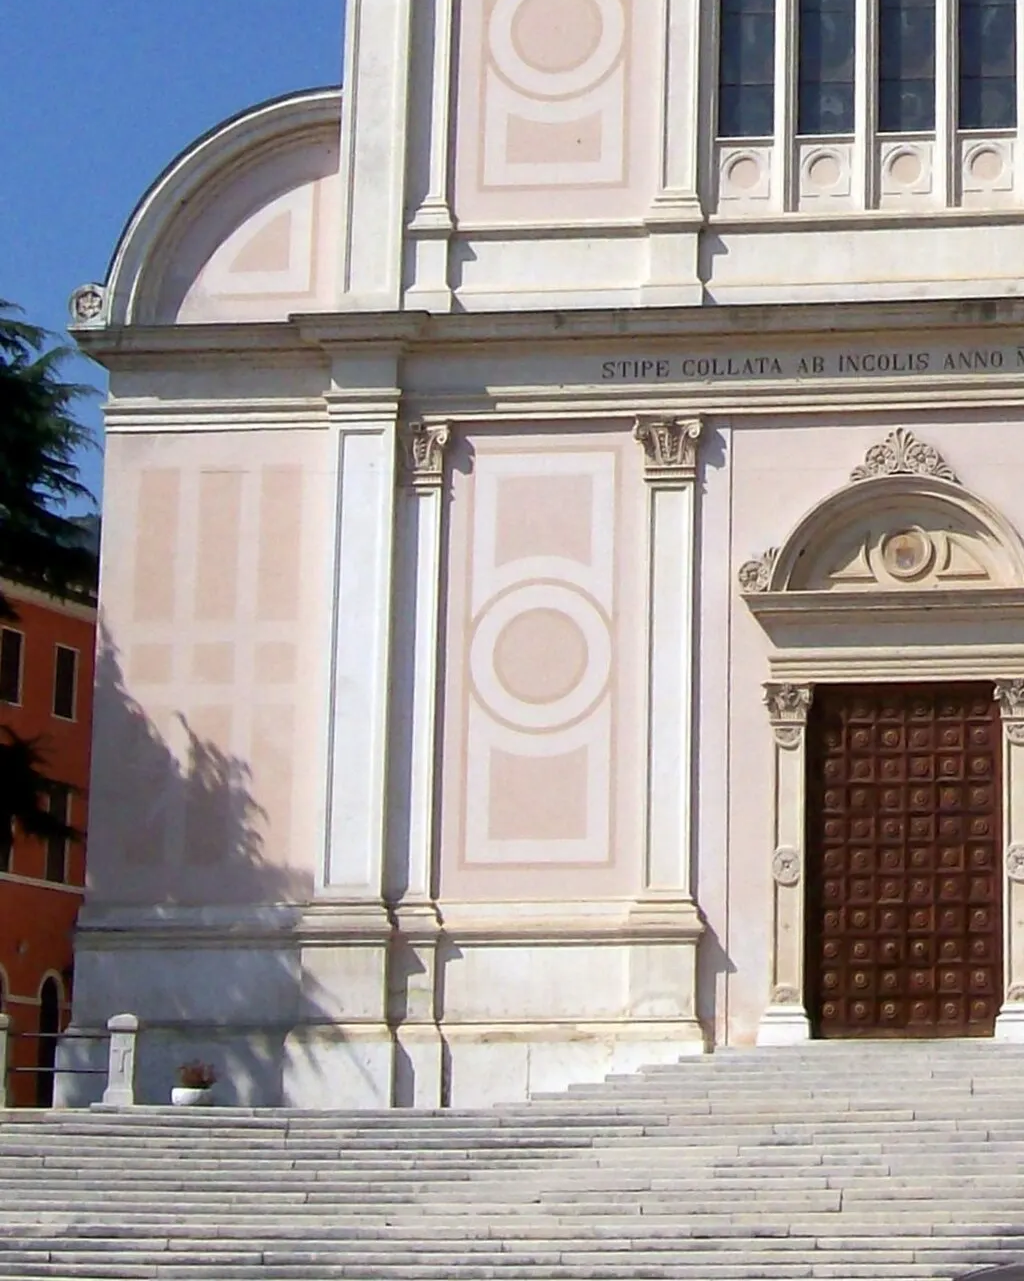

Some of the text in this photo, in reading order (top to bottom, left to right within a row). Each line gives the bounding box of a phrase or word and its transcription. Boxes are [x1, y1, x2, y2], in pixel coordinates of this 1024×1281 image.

[601, 359, 670, 379] STIPE
[682, 357, 783, 377] COLLATA
[797, 356, 825, 374] AB
[838, 353, 930, 373] INCOLIS
[943, 351, 1003, 370] ANNO
